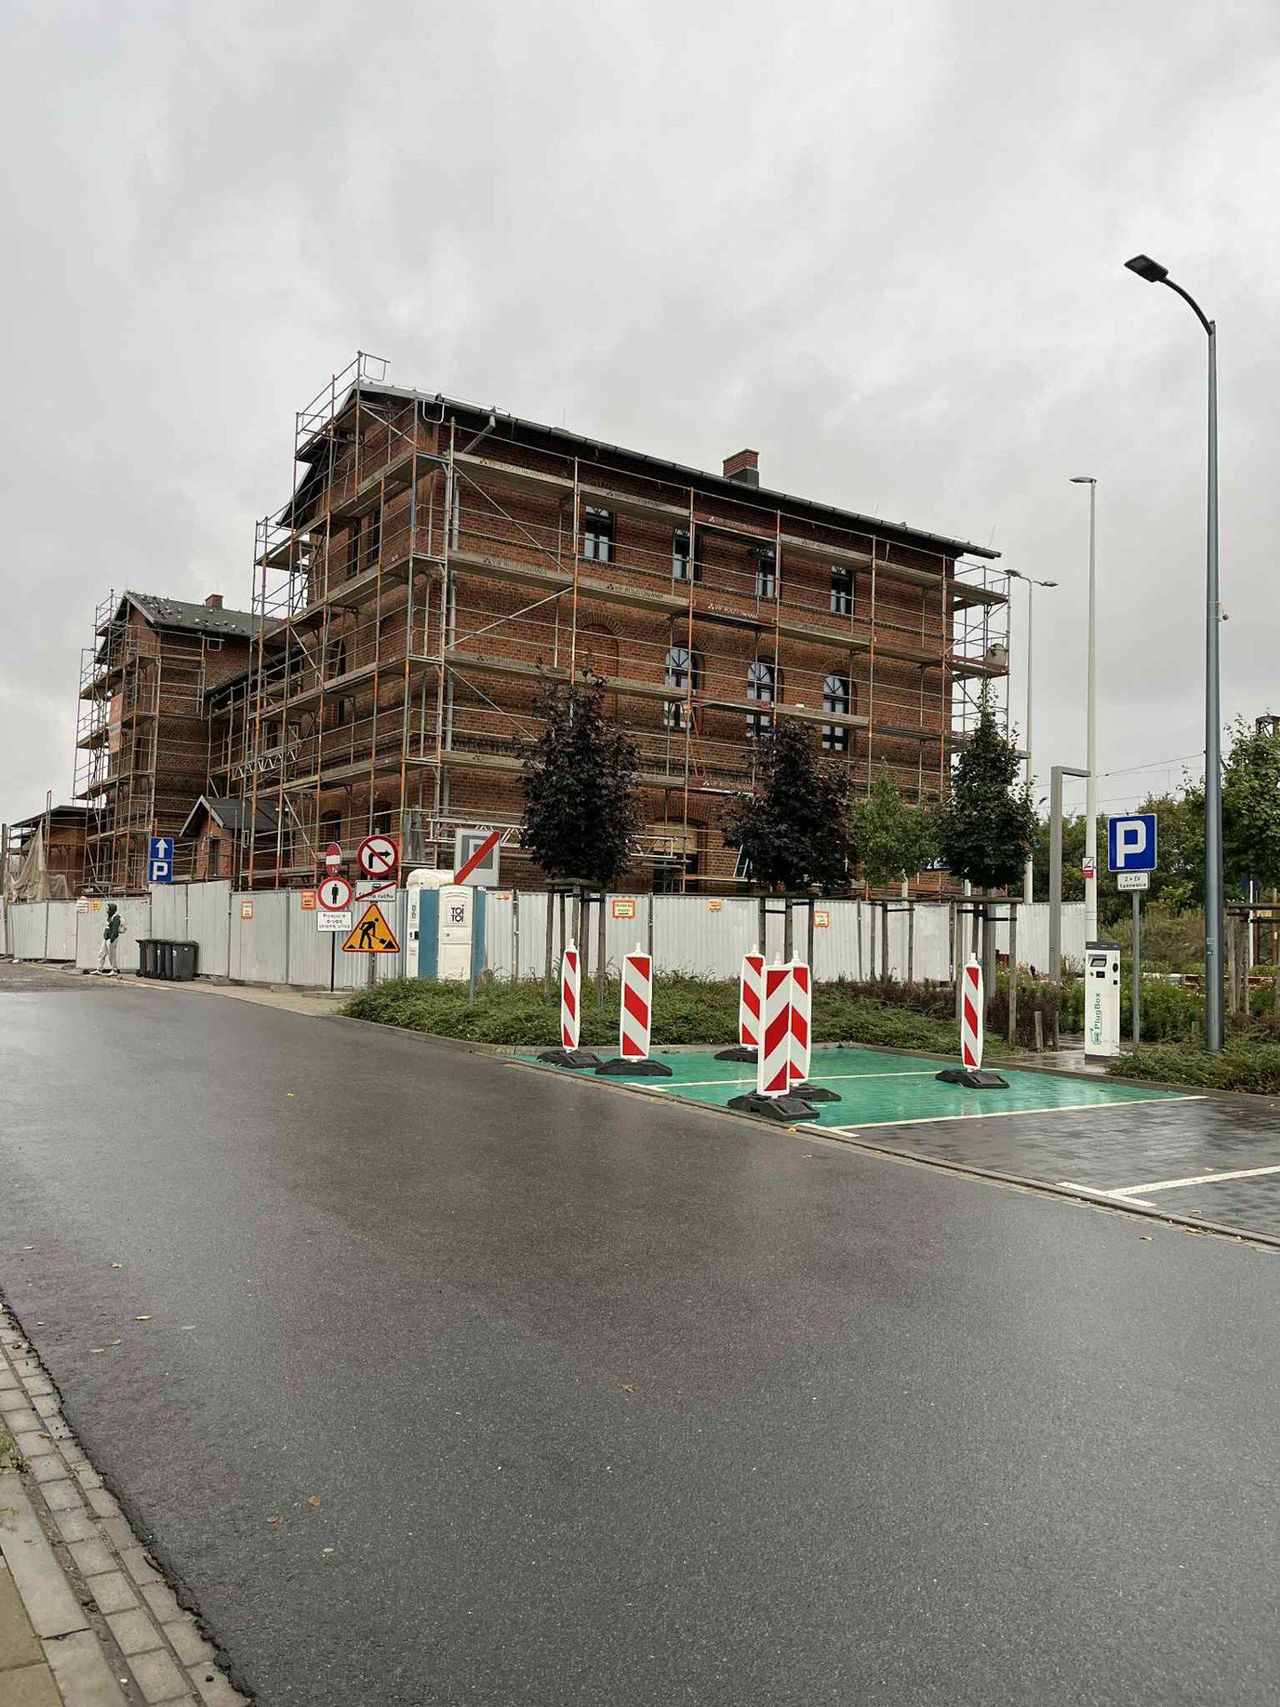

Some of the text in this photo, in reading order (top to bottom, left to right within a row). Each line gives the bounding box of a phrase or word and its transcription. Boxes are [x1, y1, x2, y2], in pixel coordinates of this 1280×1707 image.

[1116, 820, 1146, 867] P
[153, 861, 168, 880] P
[1094, 993, 1102, 1029] PlugBox
